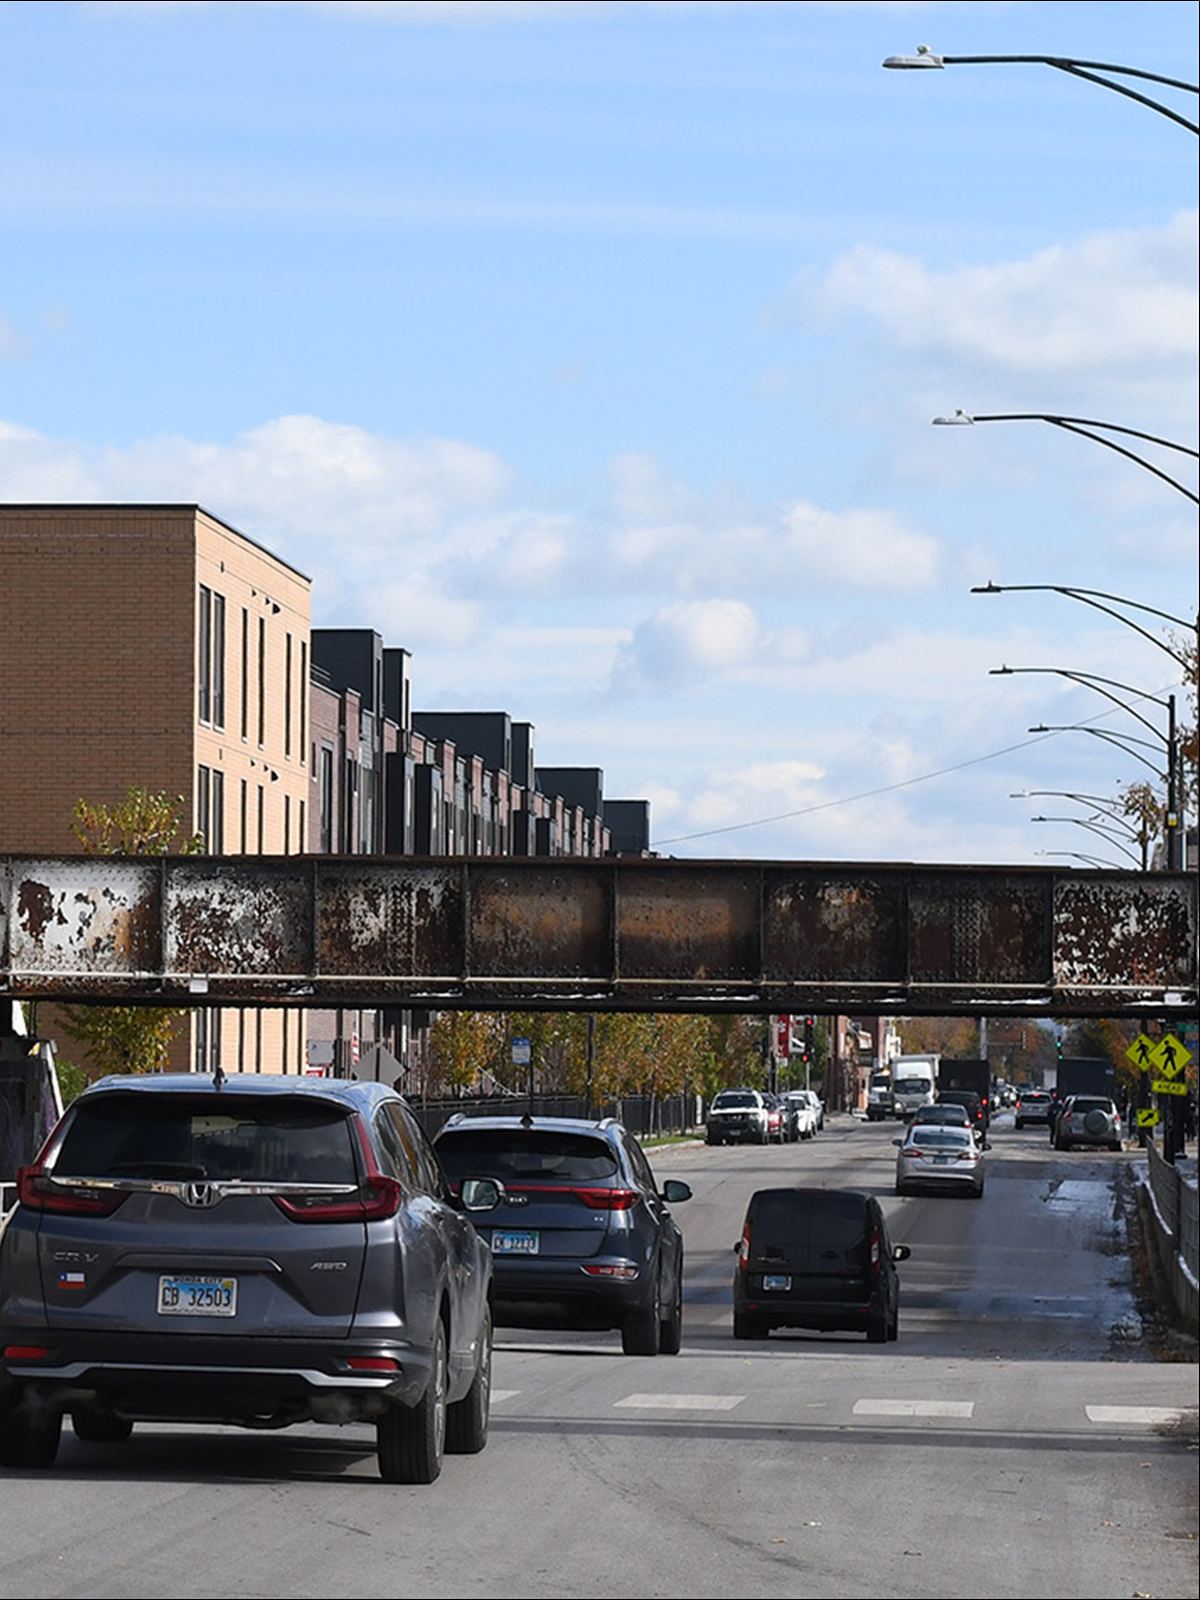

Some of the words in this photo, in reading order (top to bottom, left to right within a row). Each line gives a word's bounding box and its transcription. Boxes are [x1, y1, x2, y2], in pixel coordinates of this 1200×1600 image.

[310, 1262, 347, 1270] AWD
[162, 1287, 179, 1305] CB
[189, 1287, 231, 1307] 32503
